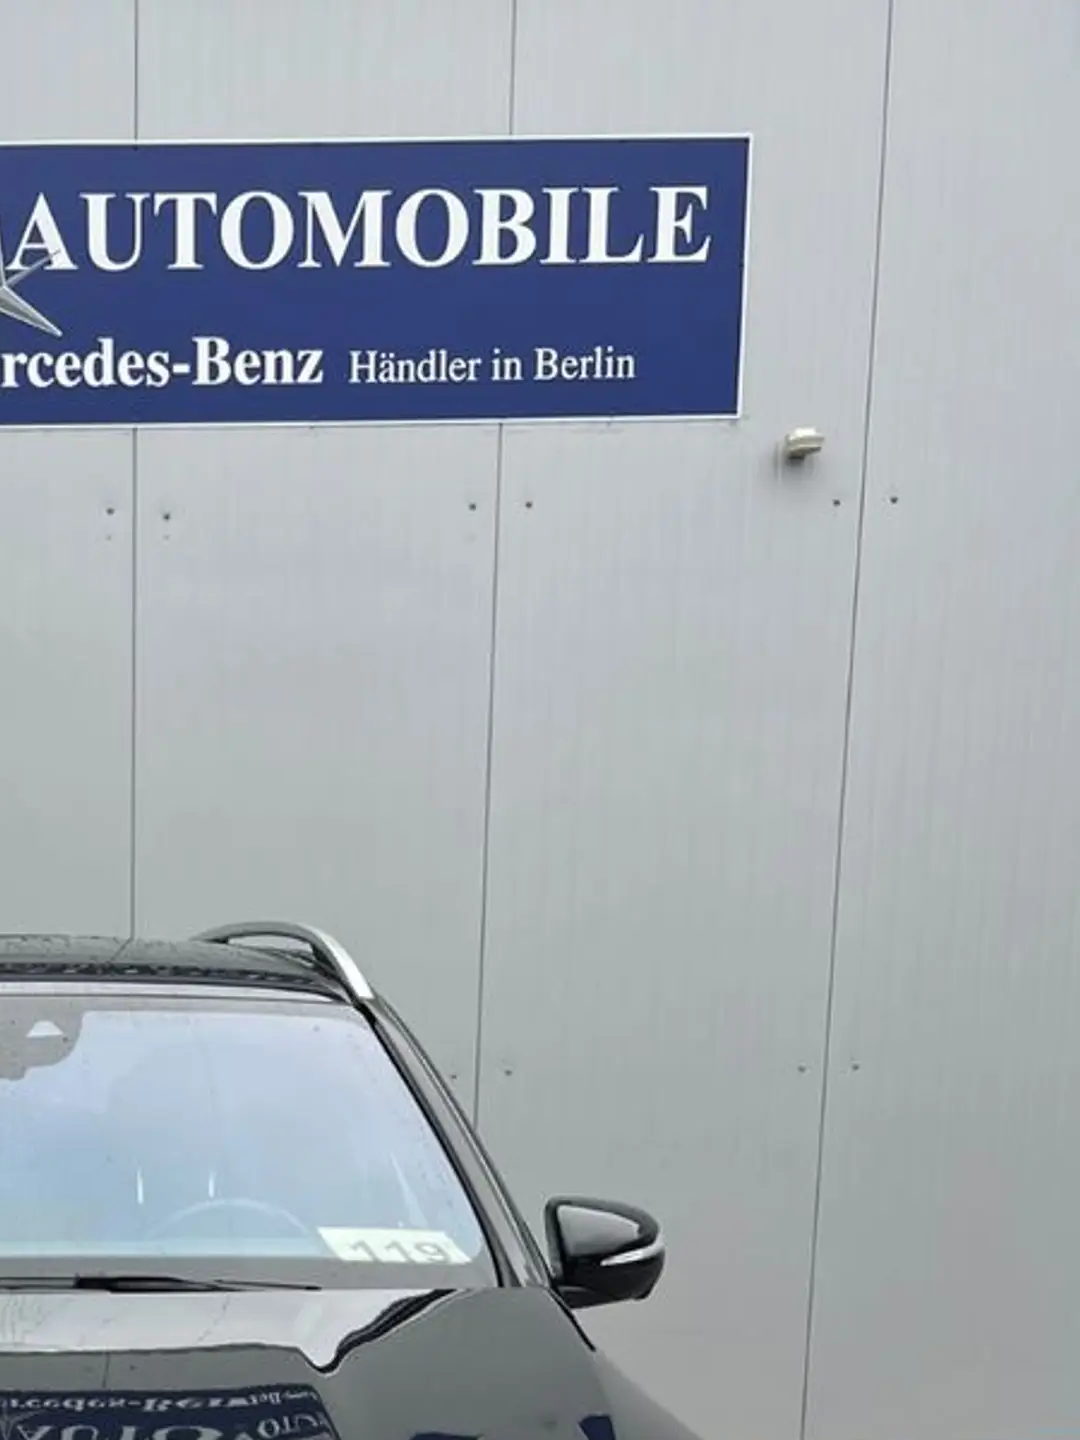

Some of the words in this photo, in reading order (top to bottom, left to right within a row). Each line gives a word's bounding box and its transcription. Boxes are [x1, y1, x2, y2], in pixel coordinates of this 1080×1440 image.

[4, 184, 711, 275] AUTOMOBILE
[348, 347, 482, 384] Händler
[491, 347, 523, 382] in
[533, 345, 636, 382] Berlin
